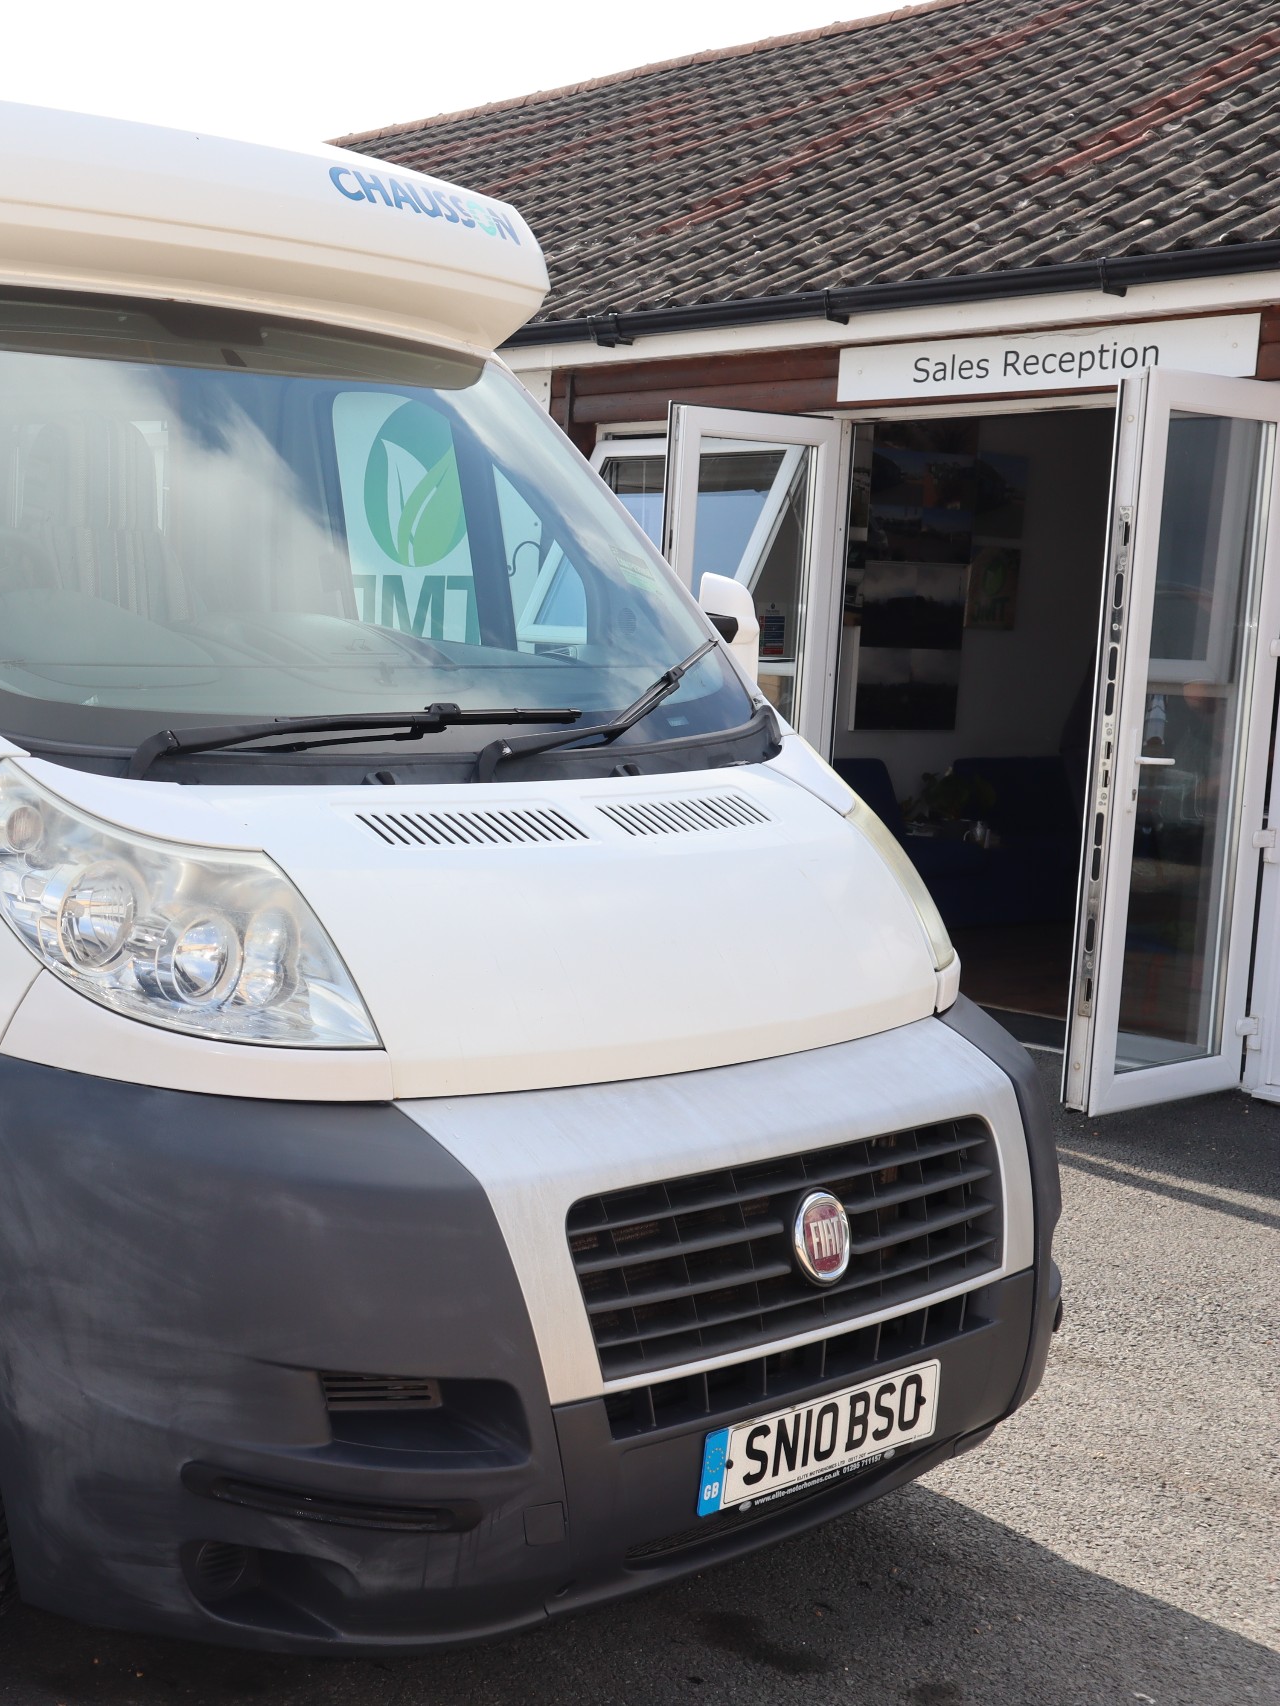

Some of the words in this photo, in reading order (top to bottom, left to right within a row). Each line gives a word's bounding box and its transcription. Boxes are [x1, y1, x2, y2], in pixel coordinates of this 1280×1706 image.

[328, 166, 521, 246] CHAUSSON
[912, 353, 990, 383] Sales
[1002, 342, 1161, 379] Reception
[809, 1216, 840, 1260] FIAT
[742, 1402, 840, 1486] SN10
[845, 1373, 923, 1453] BSO
[703, 1481, 720, 1501] GB
[754, 1470, 841, 1506] www.elite-motorhomes.co.uk
